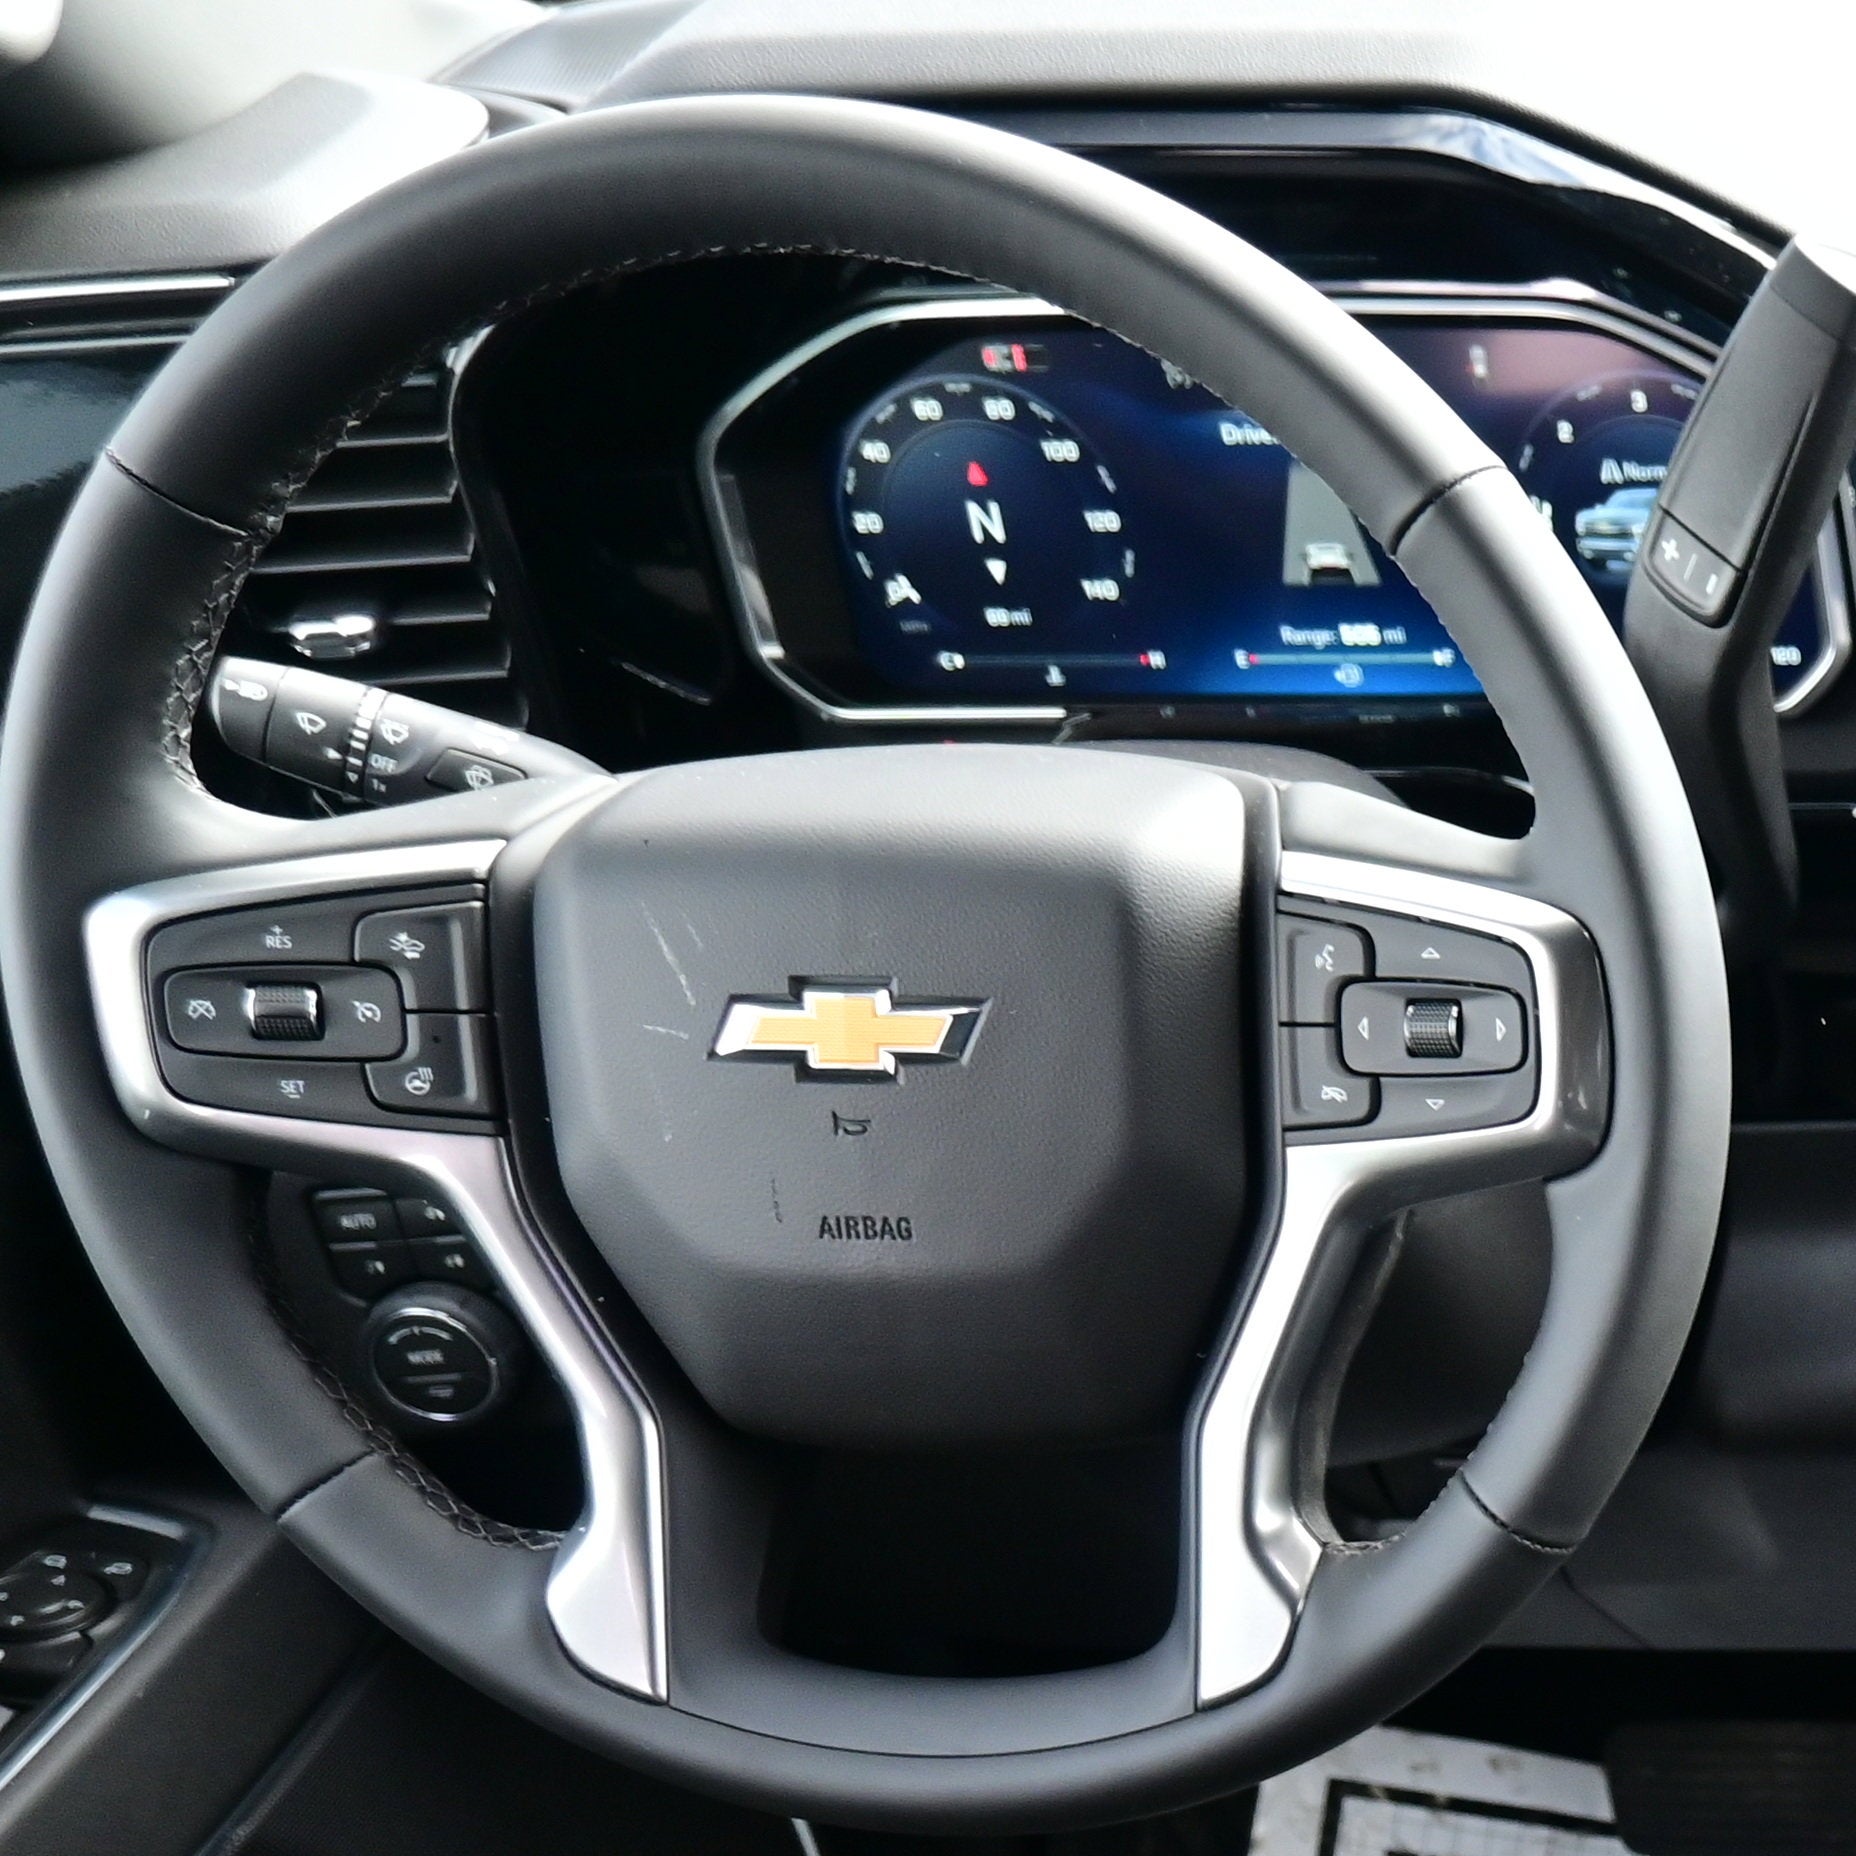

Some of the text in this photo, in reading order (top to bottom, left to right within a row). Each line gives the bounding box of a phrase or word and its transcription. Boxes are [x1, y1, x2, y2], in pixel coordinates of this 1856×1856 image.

[860, 440, 891, 464] 40
[1039, 439, 1081, 463] 100
[1622, 461, 1668, 482] Norm
[964, 499, 1007, 544] N
[371, 754, 398, 773] OFF
[265, 935, 292, 950] RES
[281, 1079, 305, 1094] SET
[818, 1215, 913, 1242] AIRBAG
